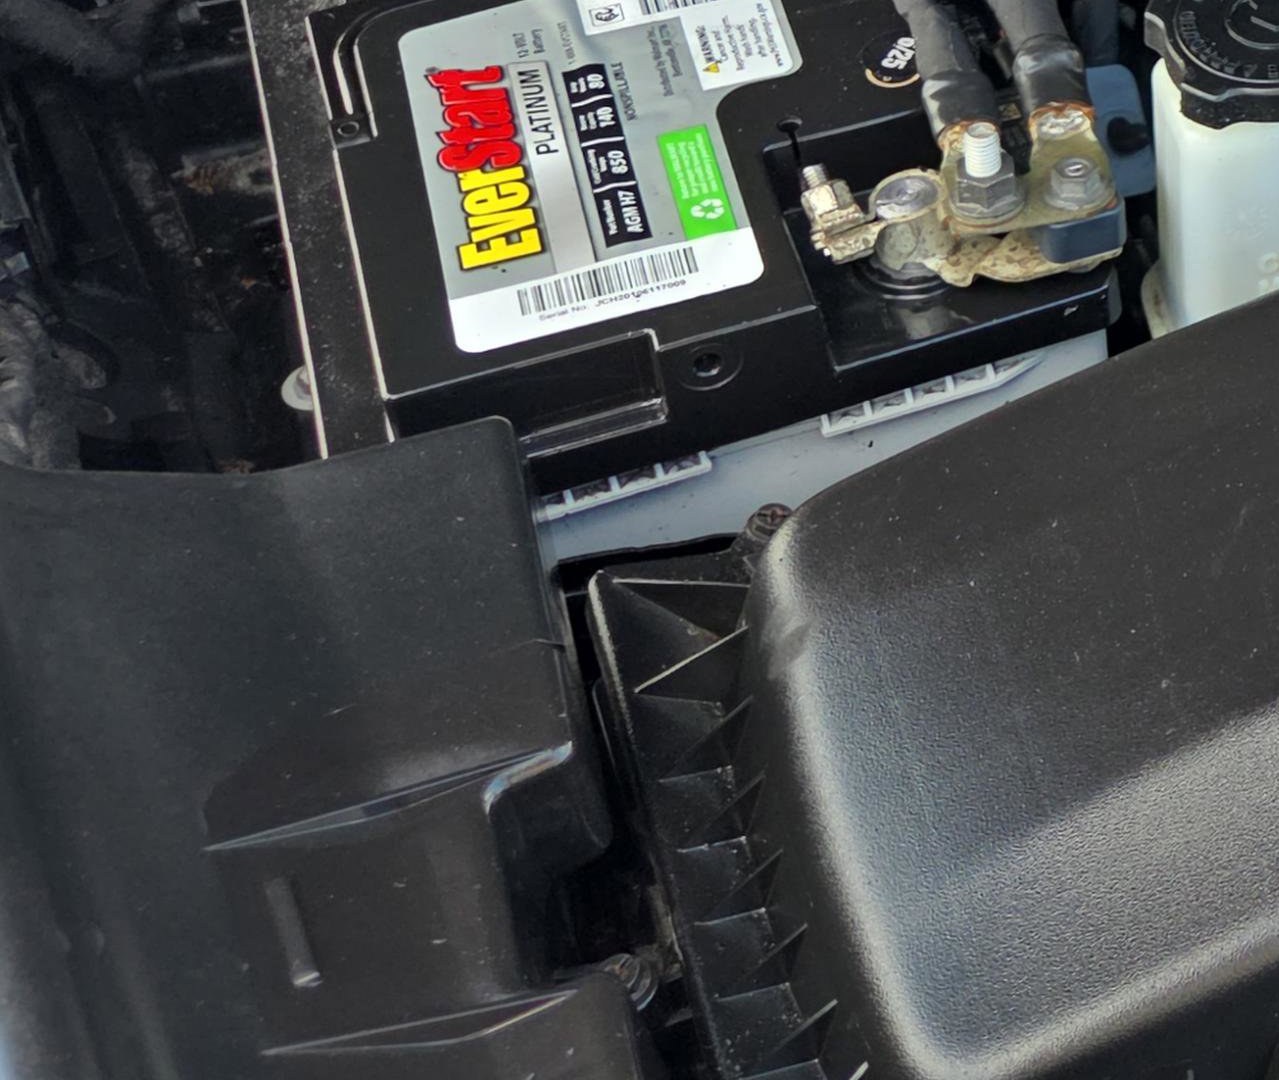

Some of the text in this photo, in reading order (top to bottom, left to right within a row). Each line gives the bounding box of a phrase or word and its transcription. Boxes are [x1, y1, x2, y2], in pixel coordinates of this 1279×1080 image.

[586, 72, 605, 89] 80
[516, 68, 557, 155] PLATINUM
[595, 105, 615, 127] 140
[424, 64, 545, 271] EverStart
[606, 149, 628, 174] 850
[617, 189, 643, 232] AGM H7
